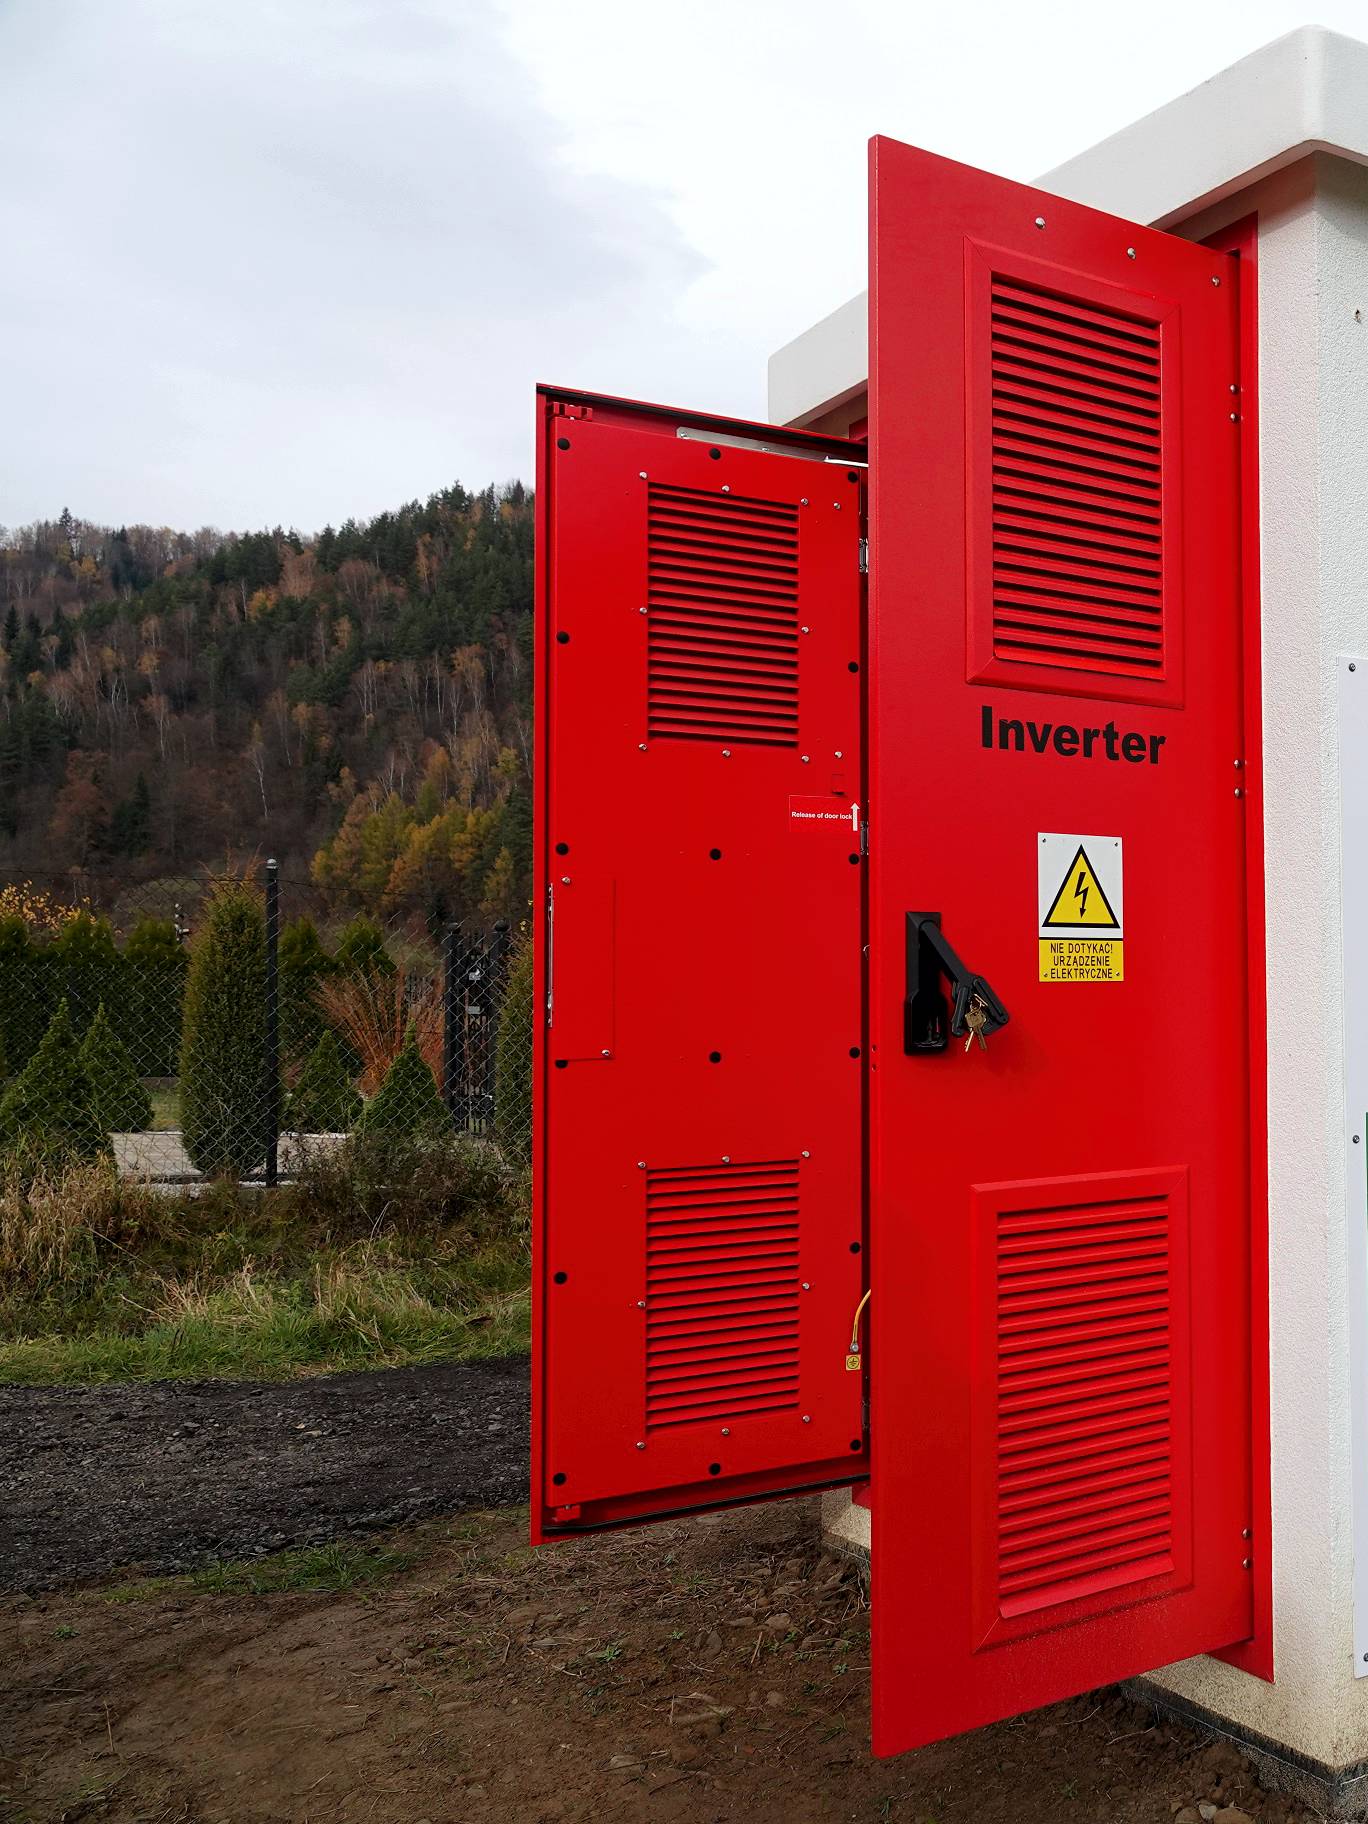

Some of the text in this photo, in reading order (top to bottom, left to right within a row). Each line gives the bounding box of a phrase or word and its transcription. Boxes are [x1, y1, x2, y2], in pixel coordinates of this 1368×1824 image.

[982, 705, 1166, 764] Inverter
[791, 811, 816, 819] Release
[824, 812, 839, 820] door
[1050, 942, 1113, 954] NIE DOTYKAĆ!
[1053, 955, 1110, 967] URZĄDZENIE
[1050, 968, 1113, 979] ELEKTRYCZNE
